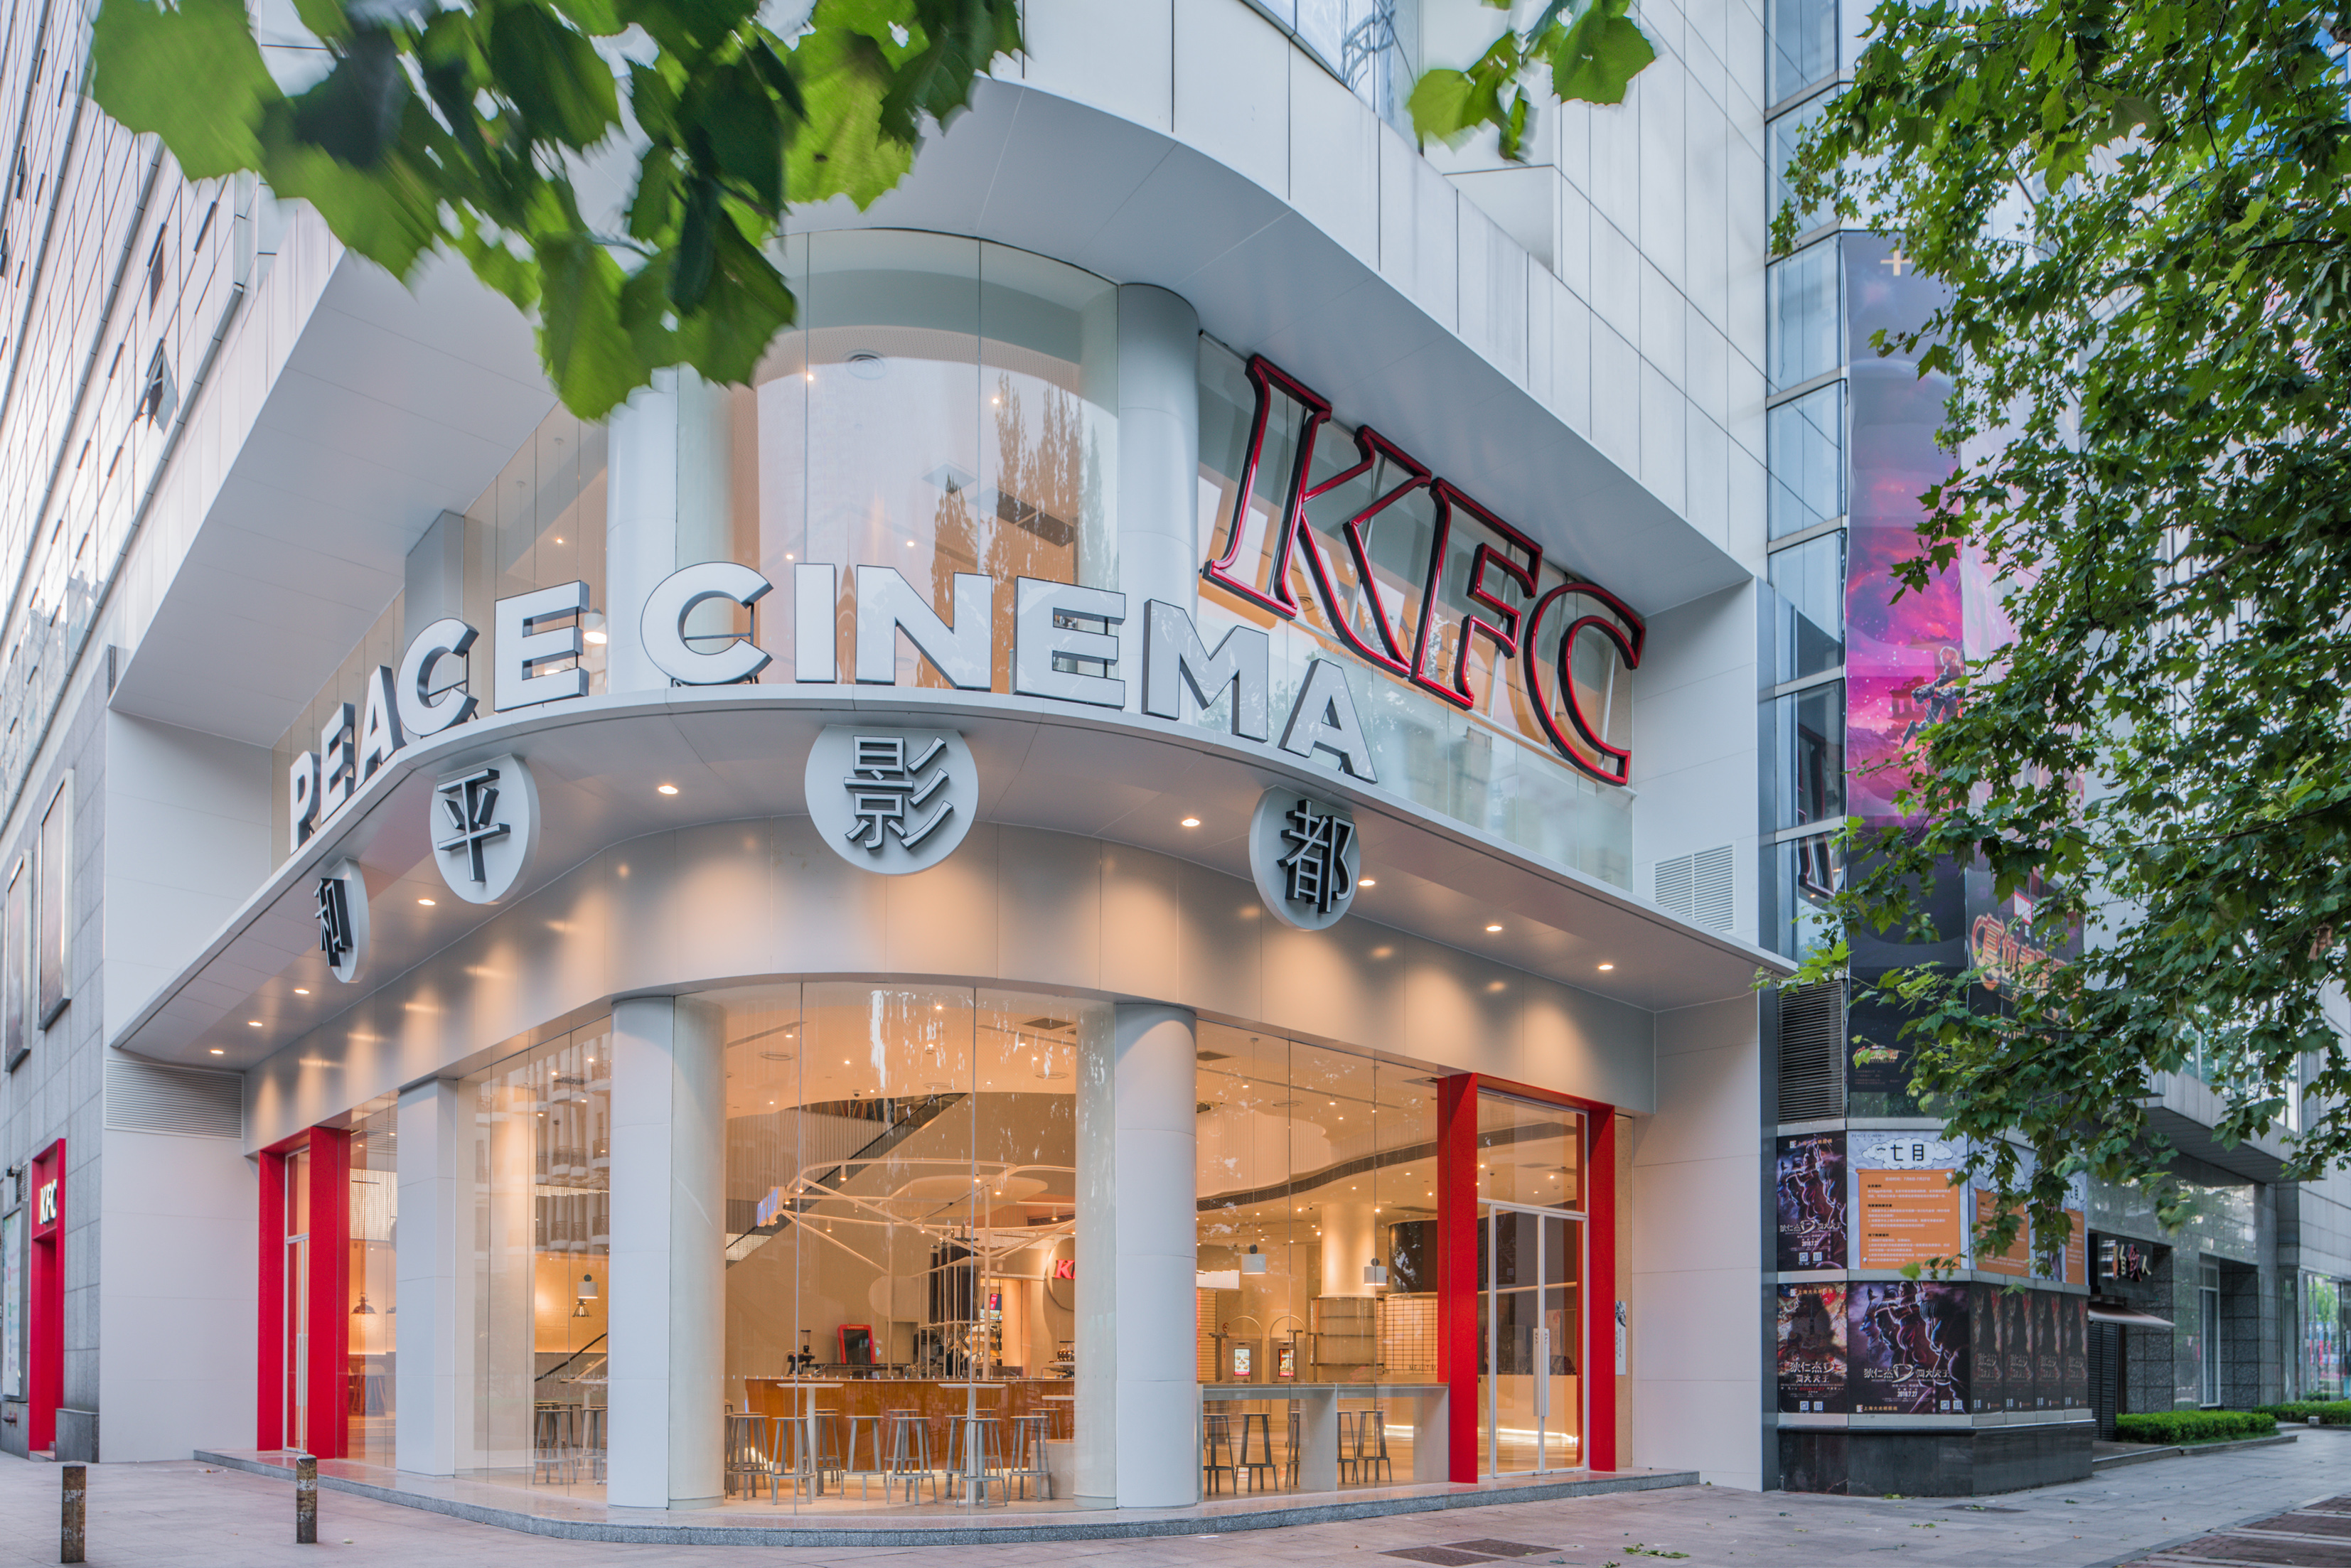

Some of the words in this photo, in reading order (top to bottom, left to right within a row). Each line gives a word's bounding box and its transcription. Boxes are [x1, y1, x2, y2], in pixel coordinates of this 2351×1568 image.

[1202, 355, 1646, 786] KFC
[289, 580, 589, 856] PEACE
[640, 562, 1378, 783] CINEMA
[437, 768, 510, 884] 平
[843, 735, 954, 852] 影
[1277, 798, 1355, 914] 都
[39, 1178, 57, 1225] KFC
[1890, 1144, 1924, 1161] 七月
[1054, 1260, 1075, 1279] K
